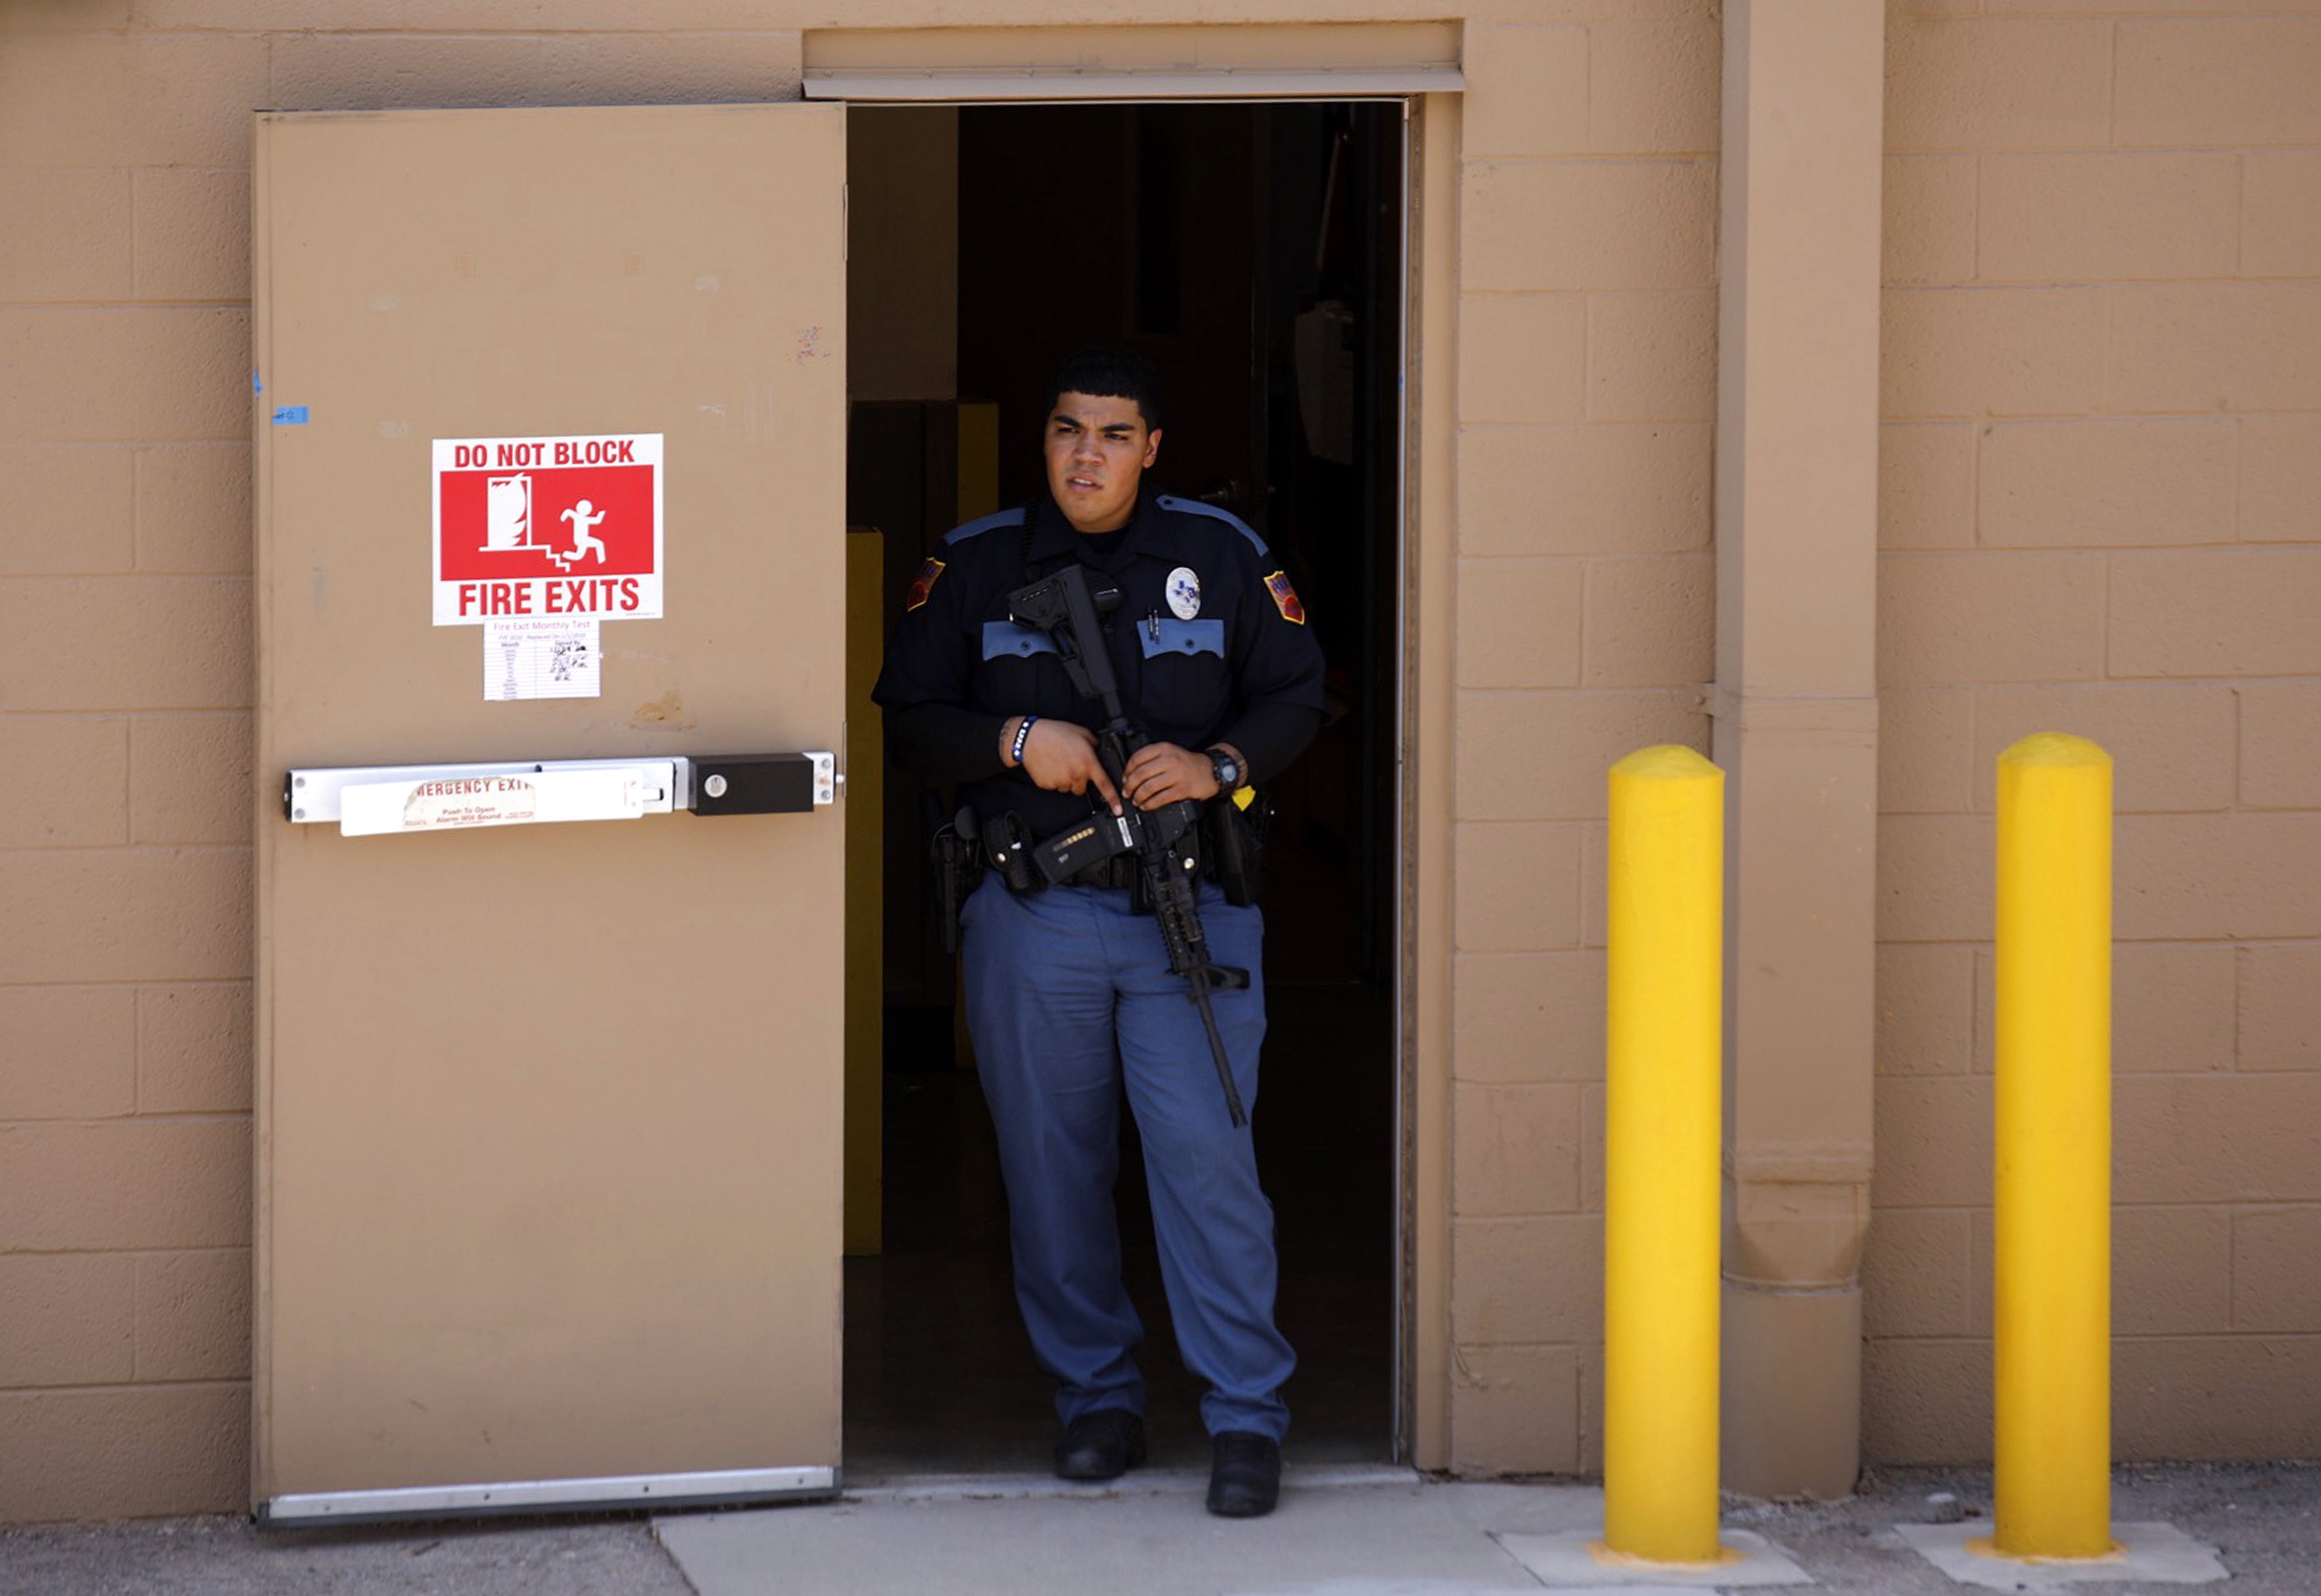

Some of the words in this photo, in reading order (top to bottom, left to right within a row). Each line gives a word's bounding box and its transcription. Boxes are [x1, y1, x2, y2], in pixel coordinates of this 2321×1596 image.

[455, 445, 488, 468] DO
[497, 443, 545, 467] NOT
[554, 440, 635, 465] BLOCK
[459, 582, 532, 616] FIRE
[545, 578, 639, 613] EXITS
[532, 621, 569, 631] Monthly
[417, 779, 491, 796] MERGENCY
[477, 813, 501, 821] Sound
